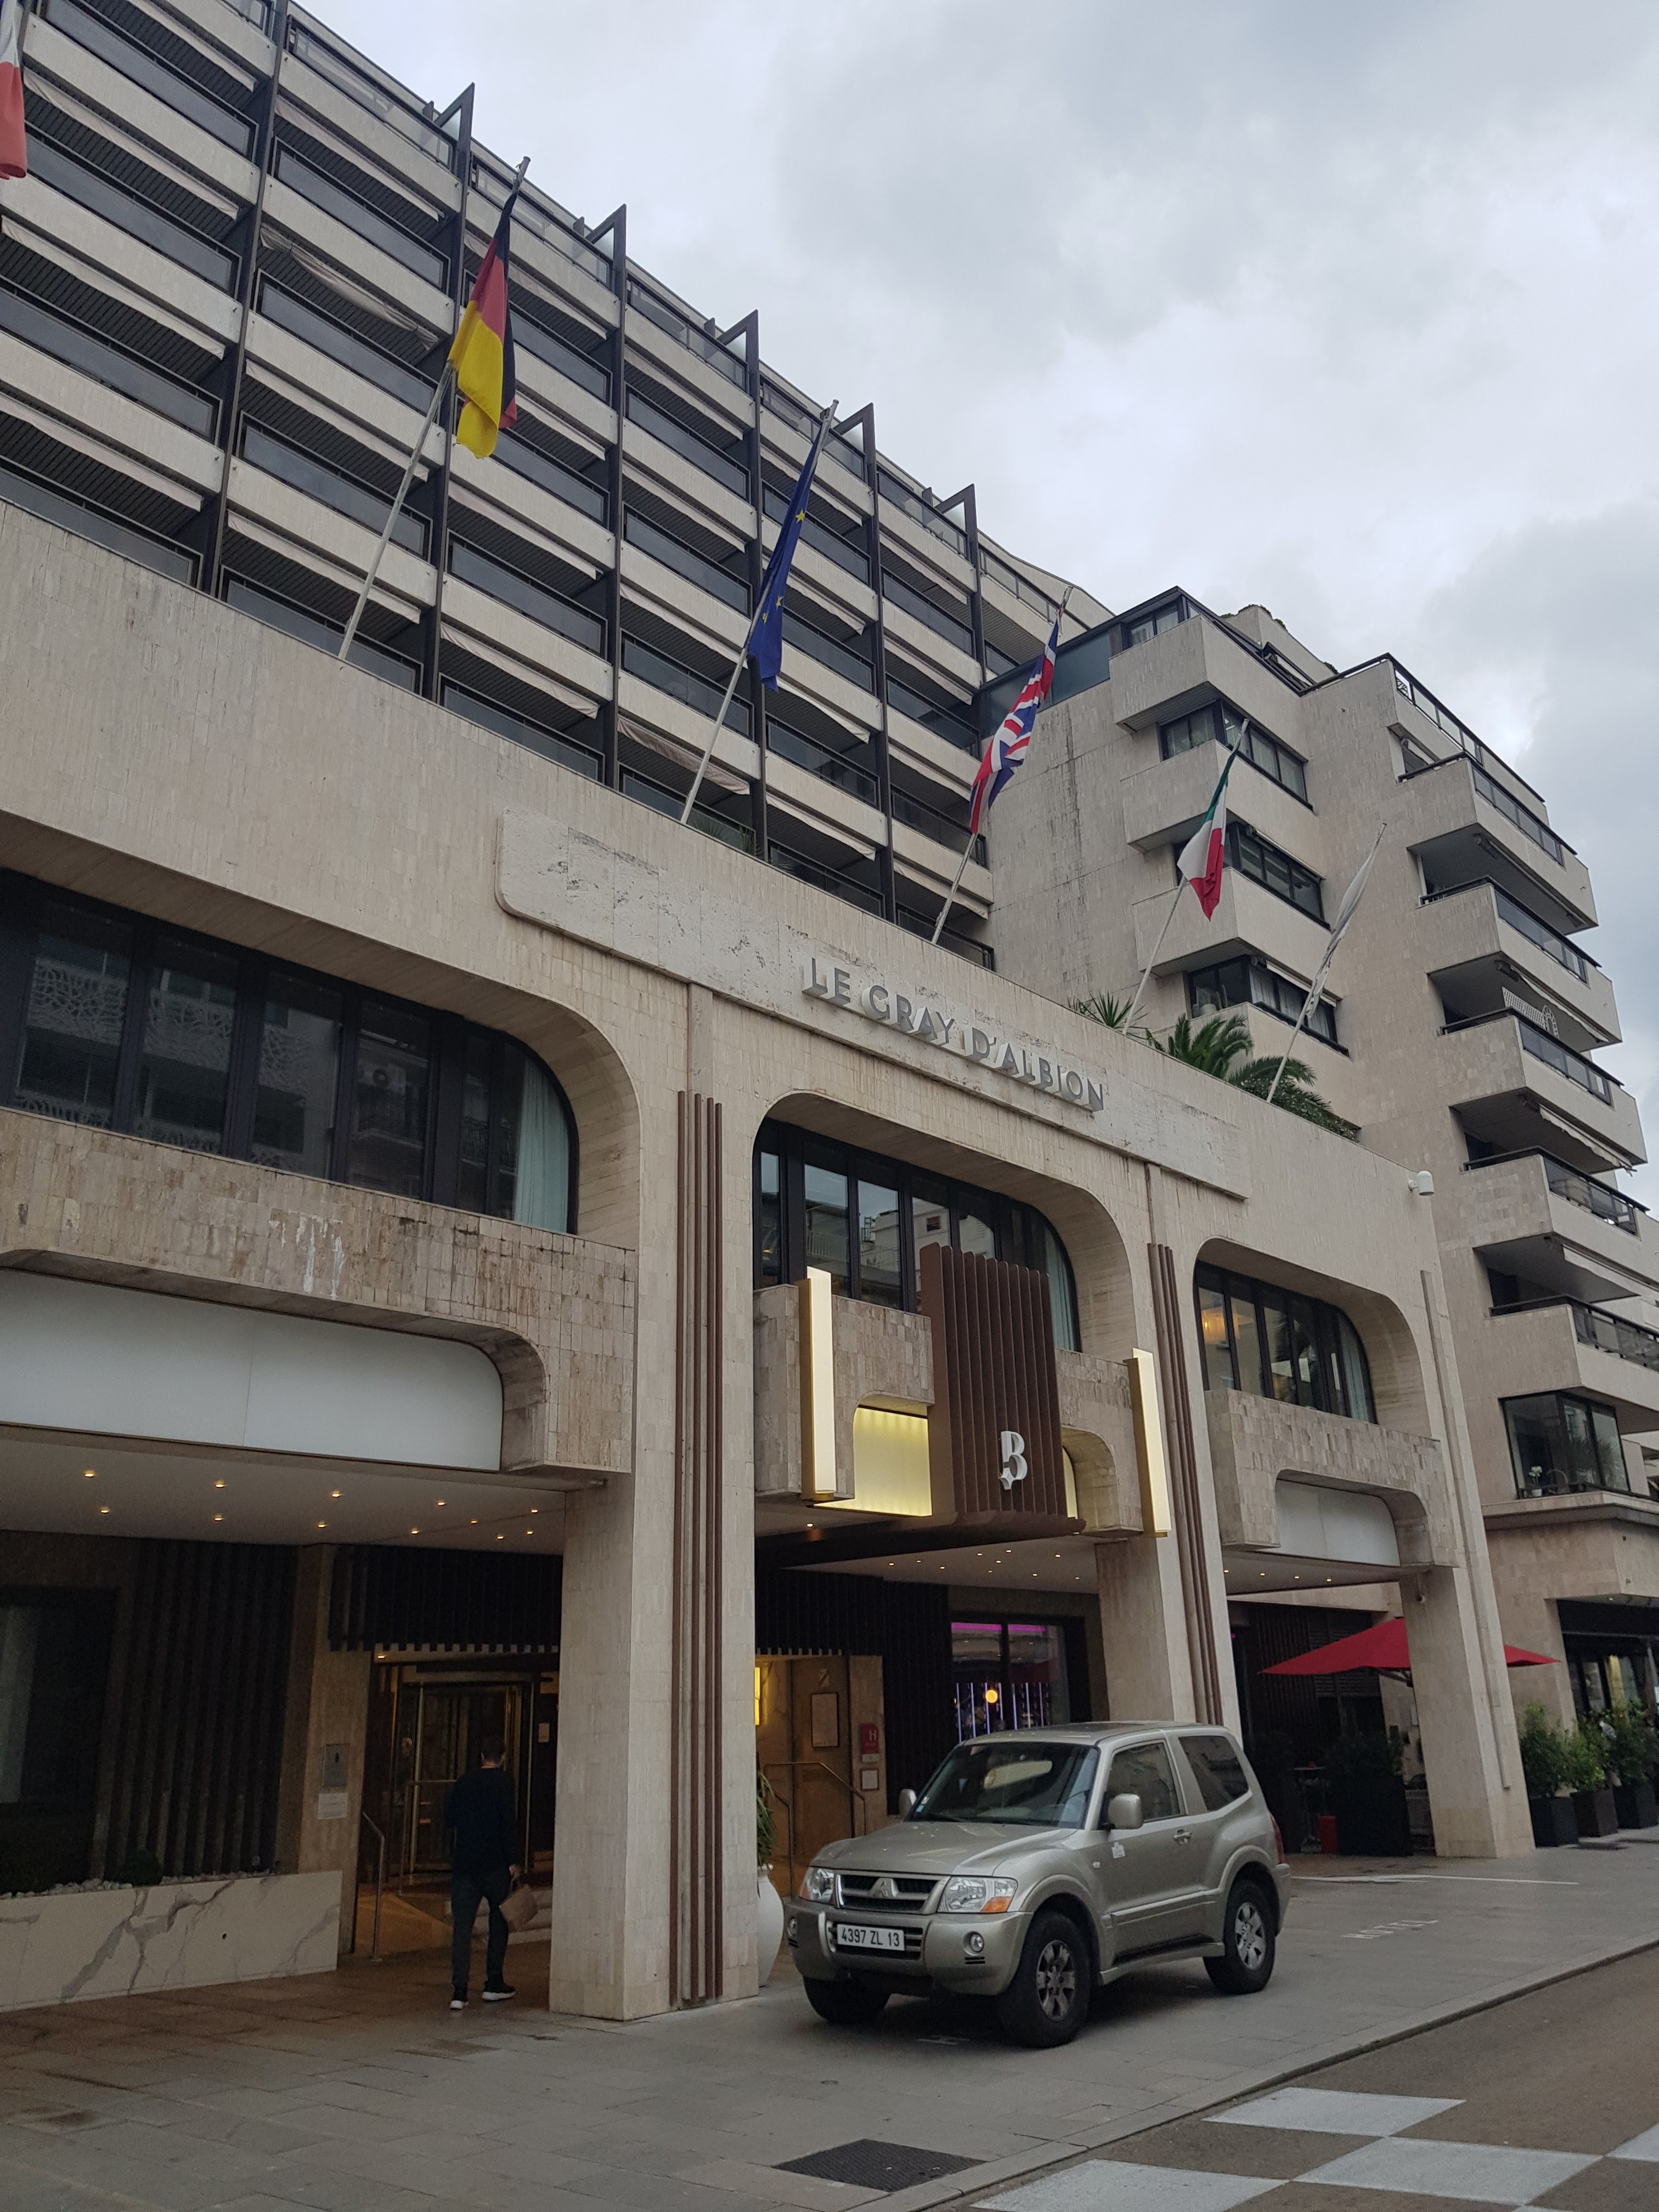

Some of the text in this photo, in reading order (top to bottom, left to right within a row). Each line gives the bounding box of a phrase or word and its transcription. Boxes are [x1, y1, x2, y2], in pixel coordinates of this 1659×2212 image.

[804, 957, 1104, 1111] LE GRAY D'ALBION
[998, 1430, 1028, 1490] B
[869, 1730, 877, 1741] H
[842, 1927, 900, 1947] 4397 ZL 13
